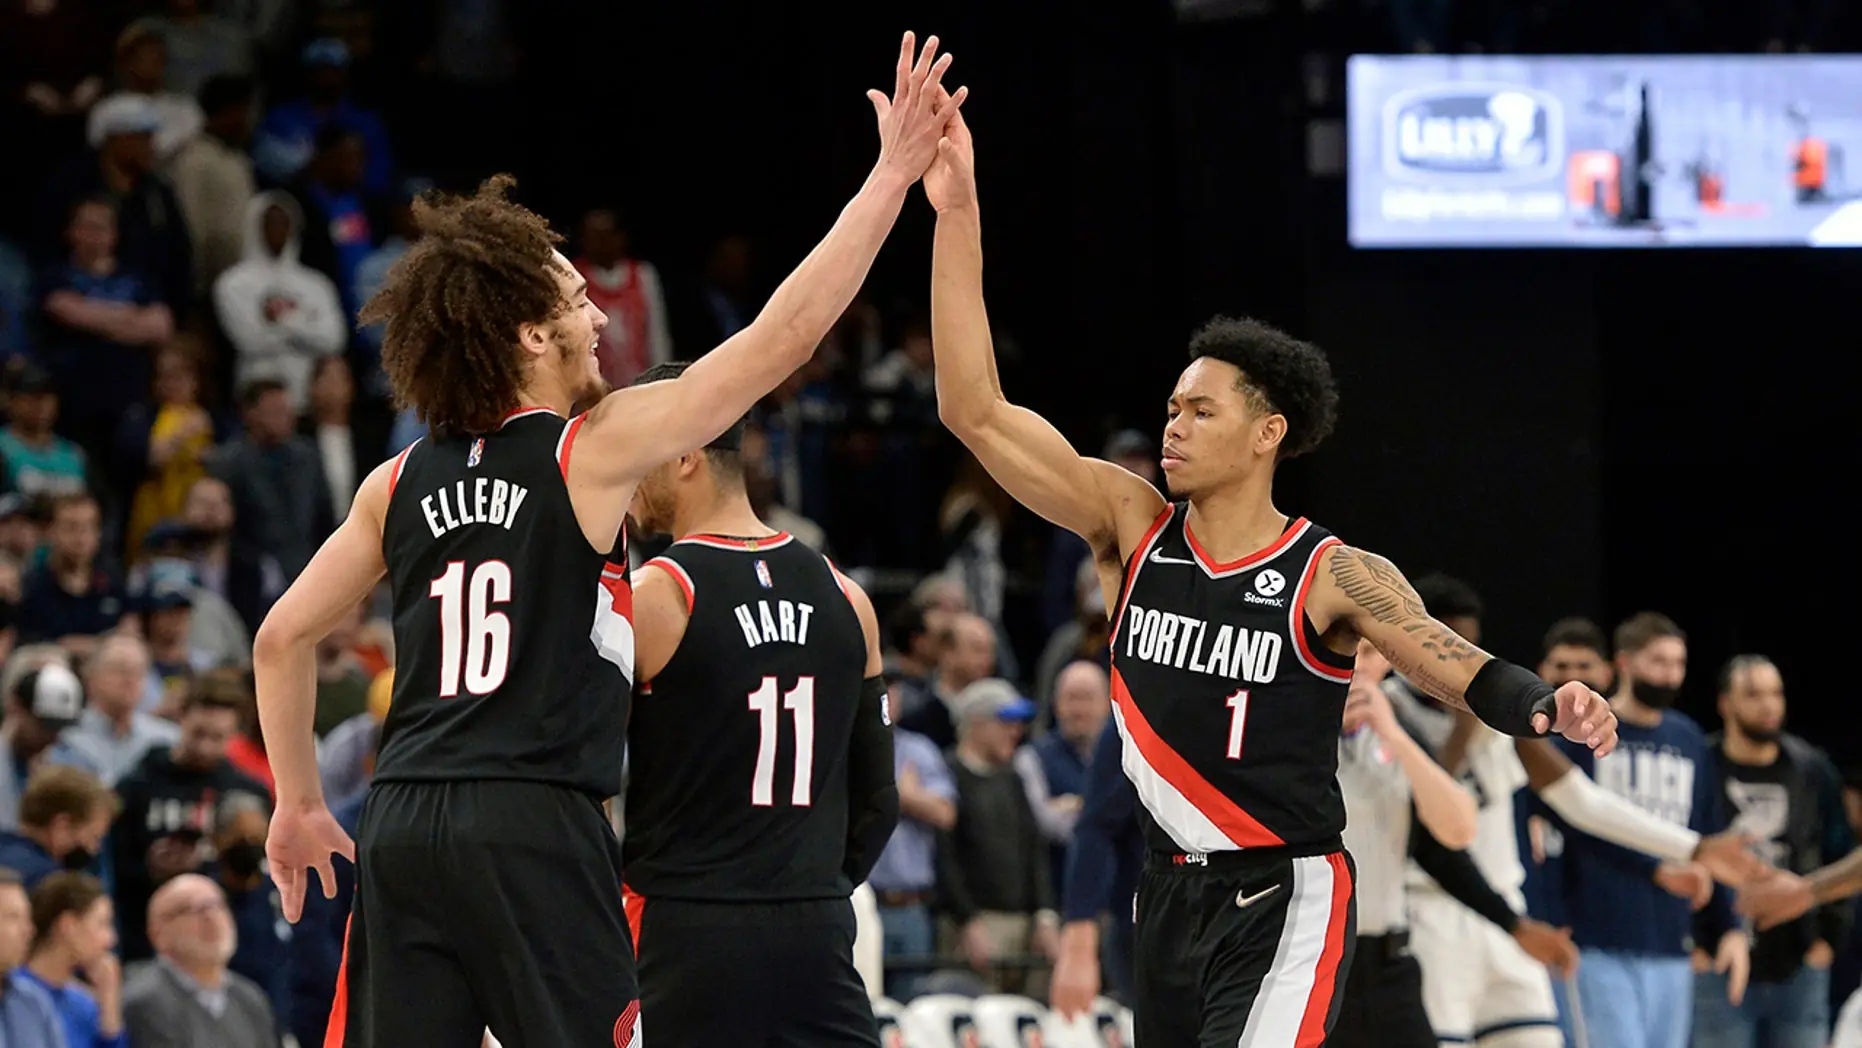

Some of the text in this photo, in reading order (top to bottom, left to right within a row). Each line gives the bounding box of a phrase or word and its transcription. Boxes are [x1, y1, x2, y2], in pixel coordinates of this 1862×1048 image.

[420, 477, 528, 539] ELLEBY
[429, 559, 512, 698] 16
[734, 600, 814, 649] HART
[1244, 591, 1285, 607] StormX
[1126, 604, 1283, 684] PORTLAND
[748, 675, 815, 807] 11
[1225, 688, 1249, 760] 1
